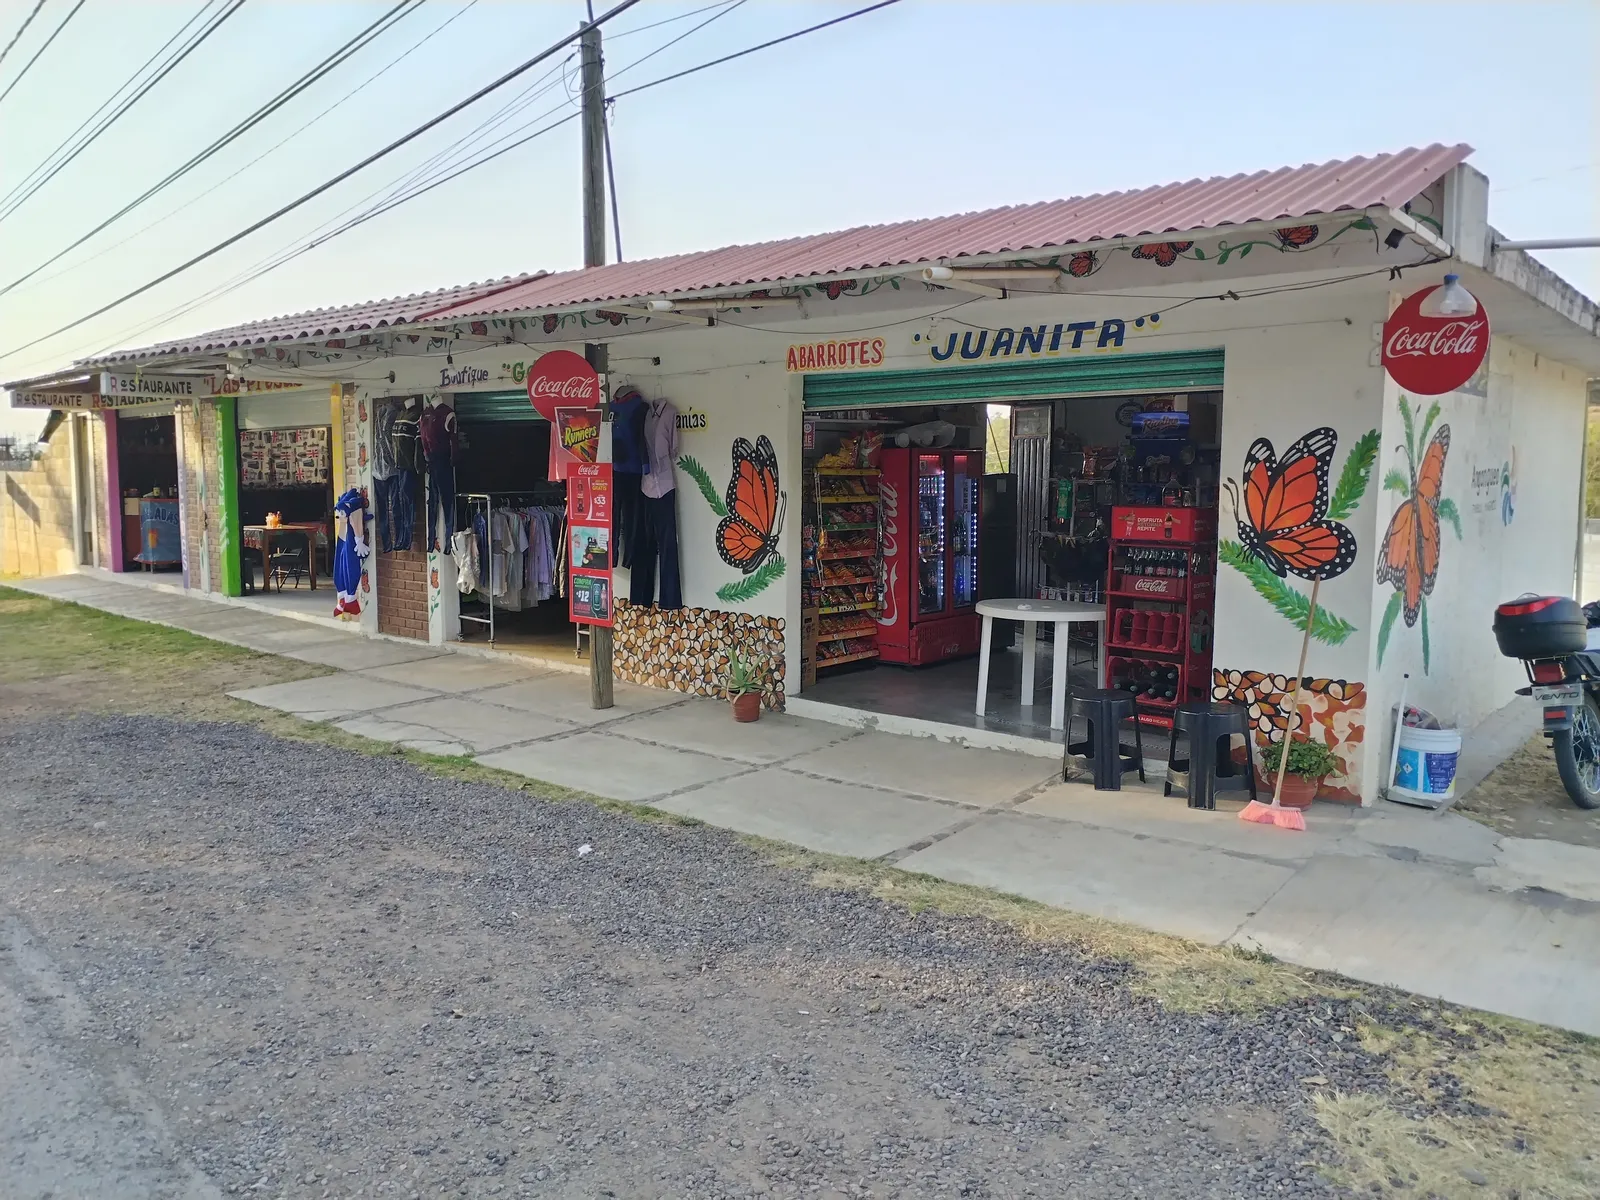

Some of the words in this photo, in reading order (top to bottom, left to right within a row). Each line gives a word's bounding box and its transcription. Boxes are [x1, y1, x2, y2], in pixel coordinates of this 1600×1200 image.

[1385, 320, 1485, 359] Coca-Cola
[788, 340, 884, 370] ABARROTES
[530, 375, 596, 399] Coca-Cola
[675, 406, 706, 429] anías
[564, 426, 597, 446] Runners
[1135, 578, 1169, 593] Coca-Cola
[1535, 691, 1579, 701] VENTO
